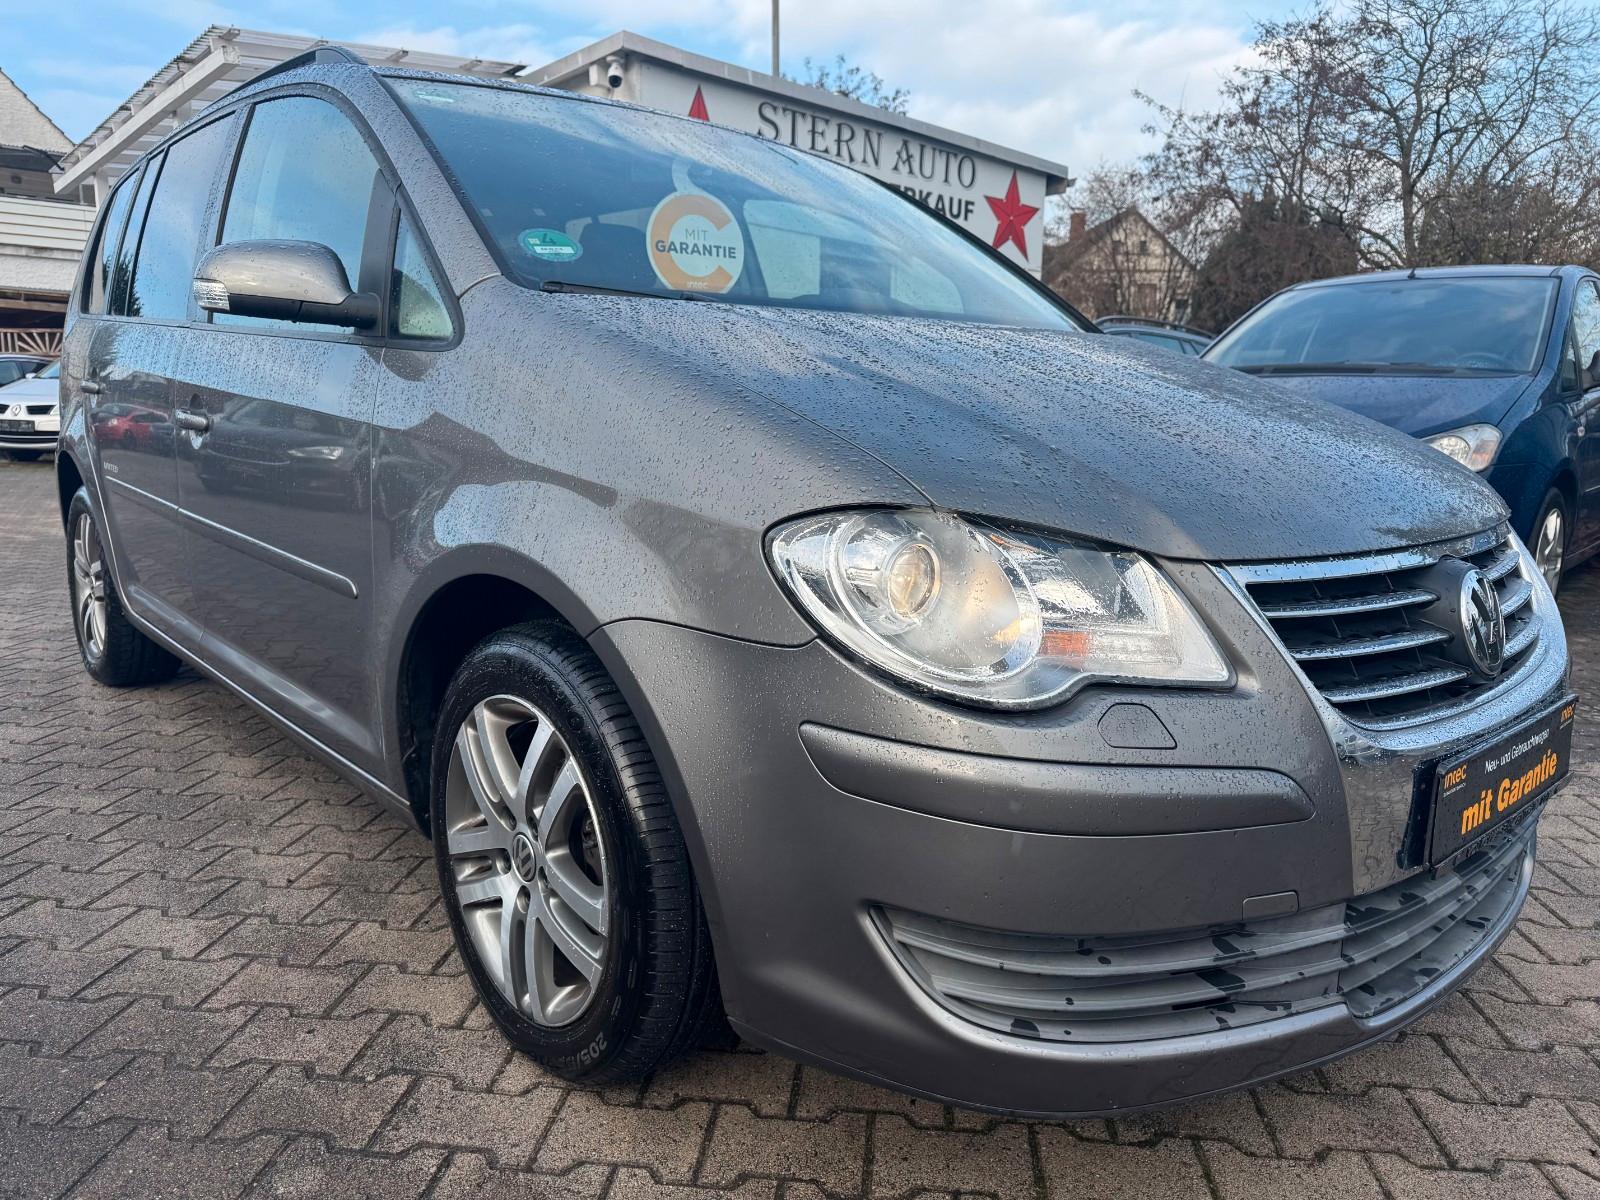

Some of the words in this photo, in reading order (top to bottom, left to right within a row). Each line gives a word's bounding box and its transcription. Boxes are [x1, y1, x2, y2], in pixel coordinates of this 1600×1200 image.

[757, 100, 885, 168] STERN
[892, 138, 977, 189] AUTO
[888, 183, 975, 221] KAUF
[655, 239, 737, 259] GARANTIE
[685, 228, 709, 241] MIT
[1500, 749, 1511, 766] und
[1461, 789, 1494, 835] mit
[1497, 748, 1557, 812] Garantie
